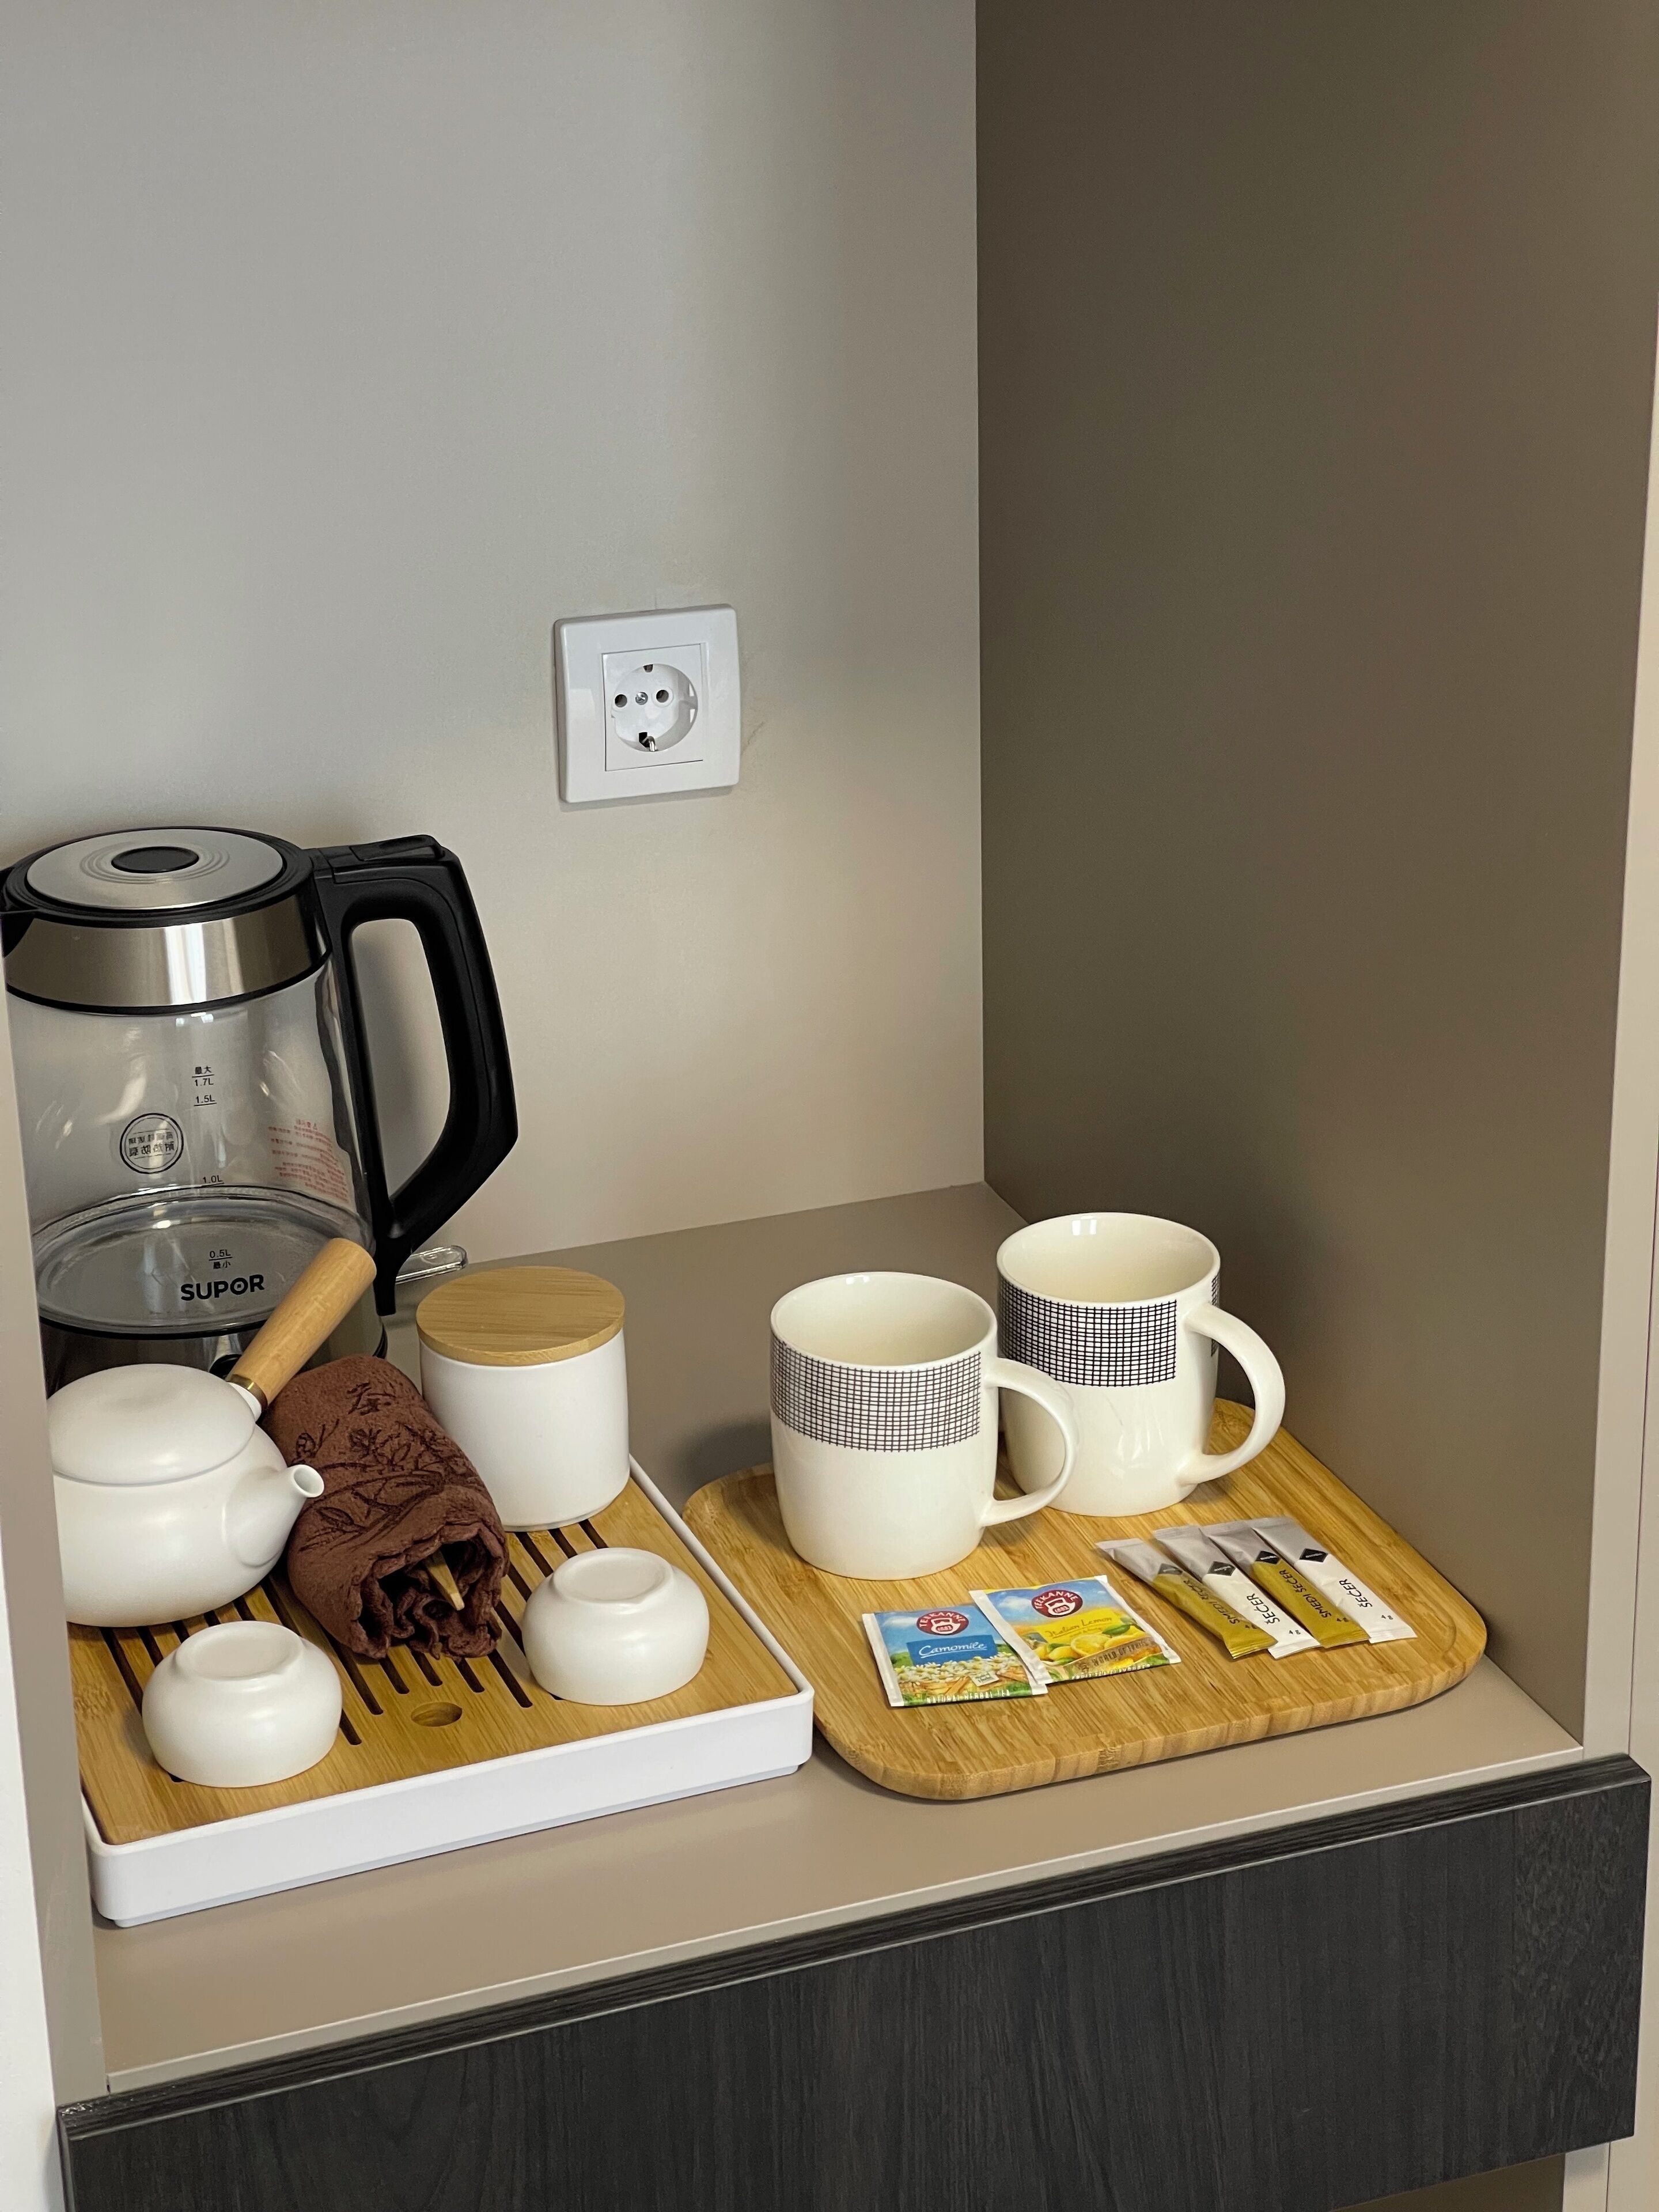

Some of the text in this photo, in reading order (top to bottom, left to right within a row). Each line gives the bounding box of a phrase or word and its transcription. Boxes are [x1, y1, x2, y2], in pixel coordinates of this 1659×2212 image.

[195, 1078, 214, 1086] 1.7L
[196, 1094, 215, 1103] 1.5L
[202, 1175, 223, 1184] 1.0L
[209, 1249, 231, 1258] 0.5L
[180, 1274, 264, 1301] SUPOR
[1033, 1591, 1078, 1609] TEEKANNE
[1339, 1578, 1373, 1608] ŠEĆER
[1246, 1593, 1281, 1625] ŠEĆER
[1045, 1625, 1080, 1637] Italian
[1081, 1617, 1112, 1626] Lemon
[919, 1641, 987, 1656] Camomile
[1092, 1651, 1118, 1666] WORLD
[1119, 1646, 1127, 1656] OF
